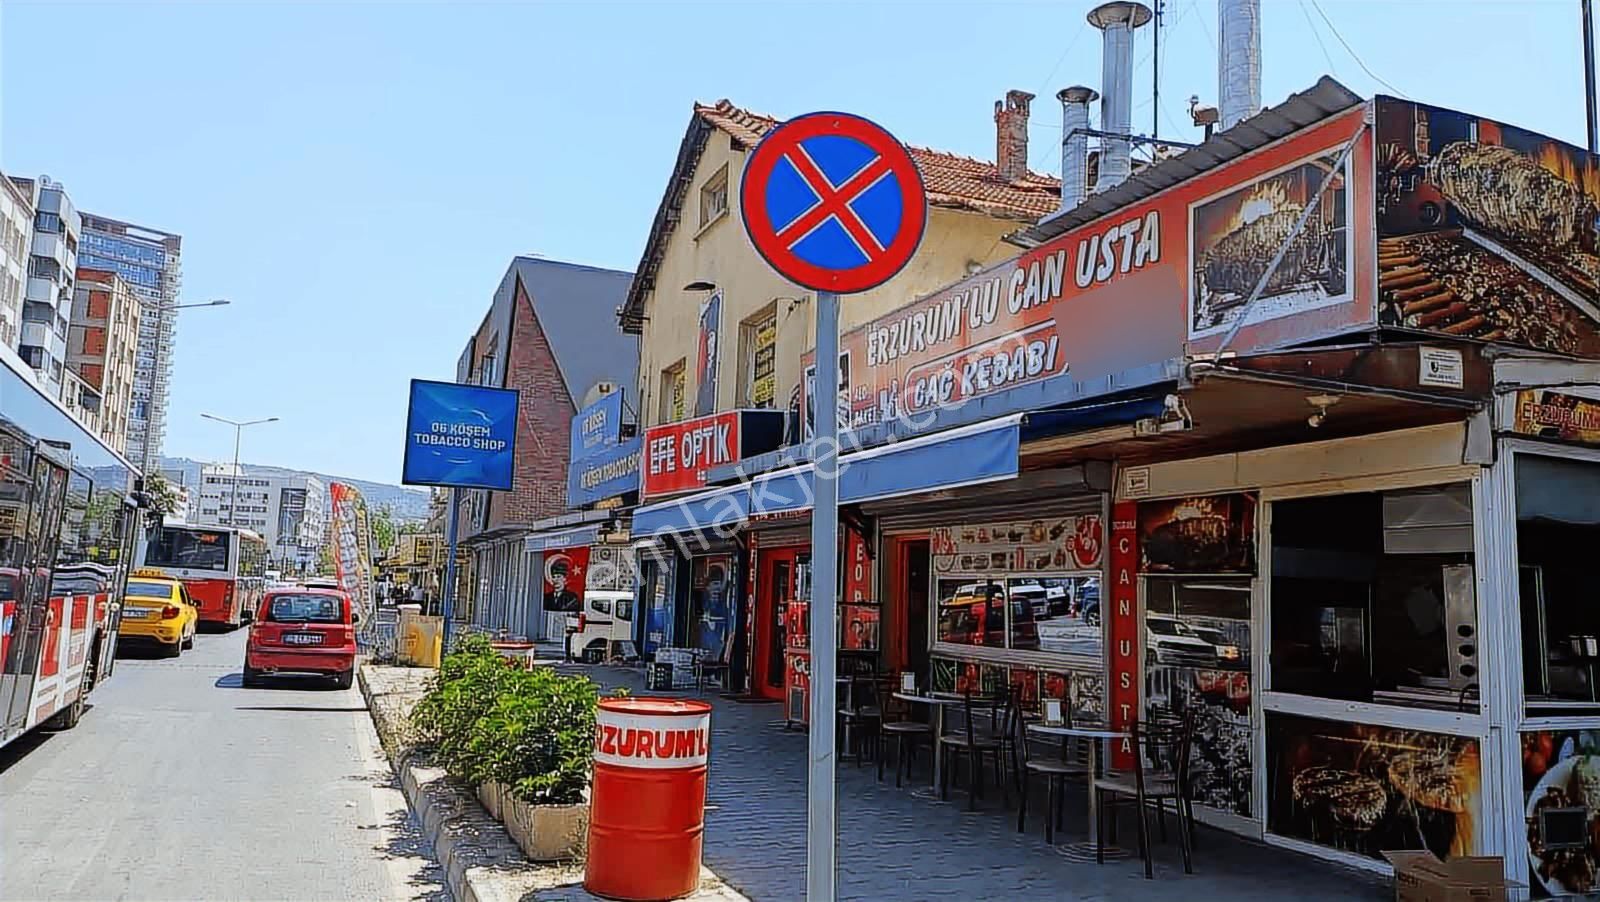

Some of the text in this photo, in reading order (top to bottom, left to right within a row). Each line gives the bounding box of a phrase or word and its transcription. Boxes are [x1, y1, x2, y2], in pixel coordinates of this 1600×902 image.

[1007, 250, 1066, 315] CAN
[1073, 210, 1162, 288] USTA
[960, 335, 1060, 396] KEBABI
[413, 432, 506, 451] TOBACCO SHOP
[650, 434, 676, 476] EFE
[1119, 538, 1131, 616] CAN
